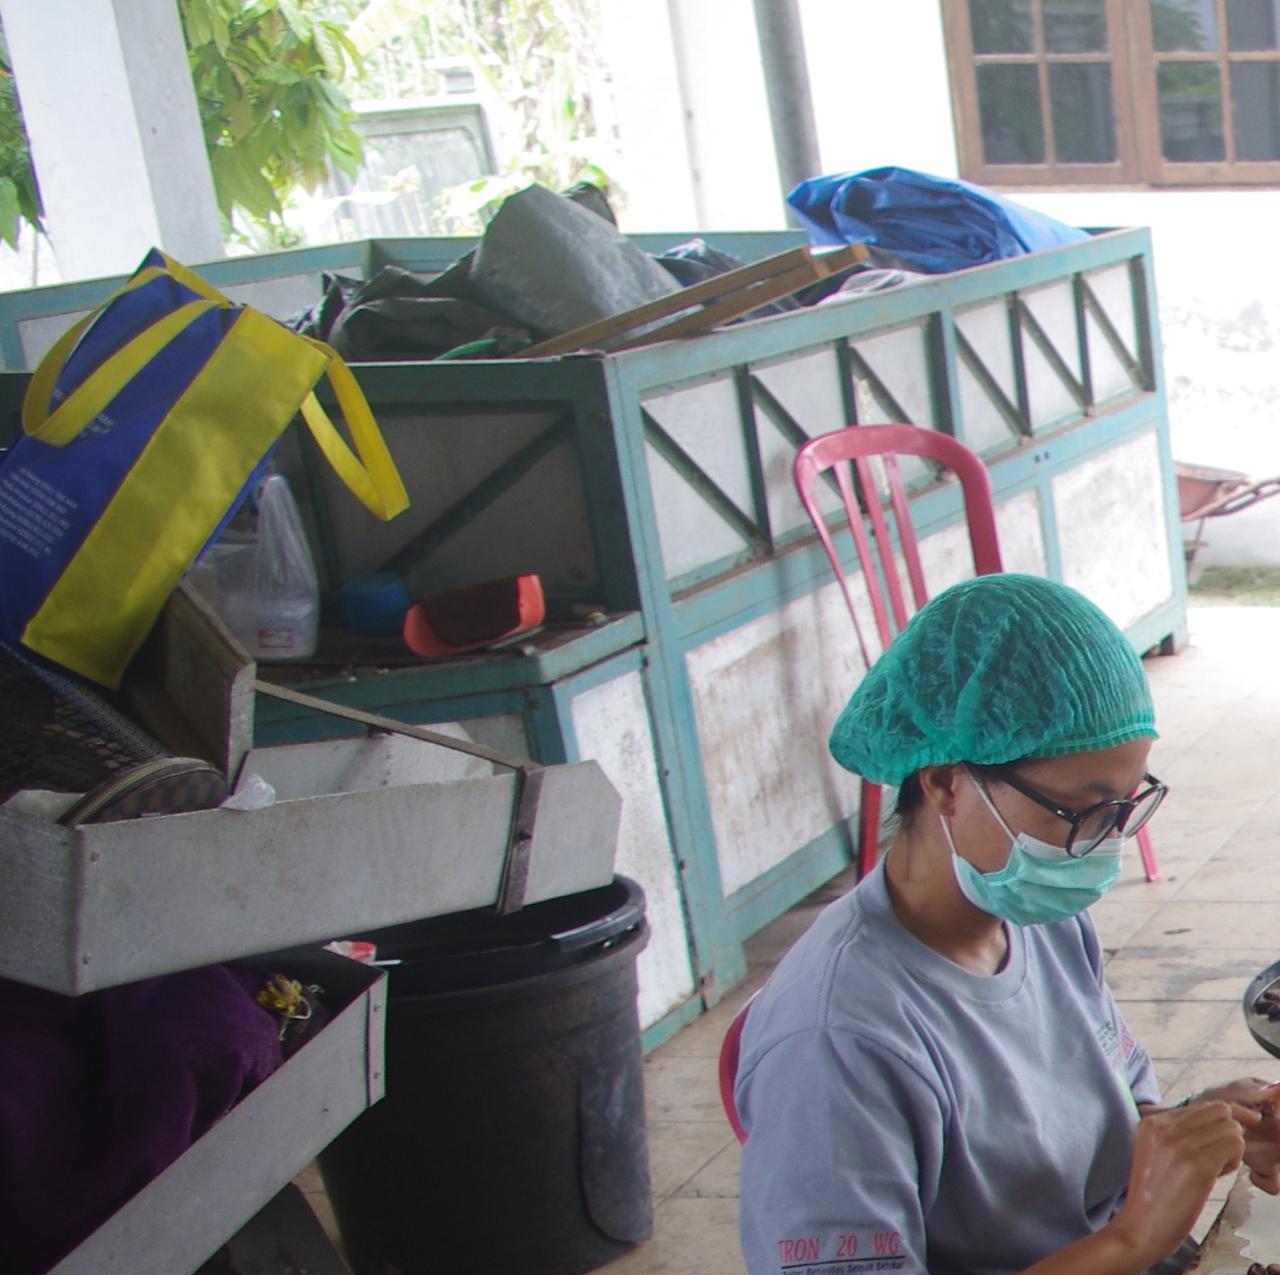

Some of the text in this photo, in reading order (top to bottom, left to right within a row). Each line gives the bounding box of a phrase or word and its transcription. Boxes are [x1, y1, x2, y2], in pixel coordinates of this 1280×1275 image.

[776, 1231, 900, 1262] TRON 20 WG
